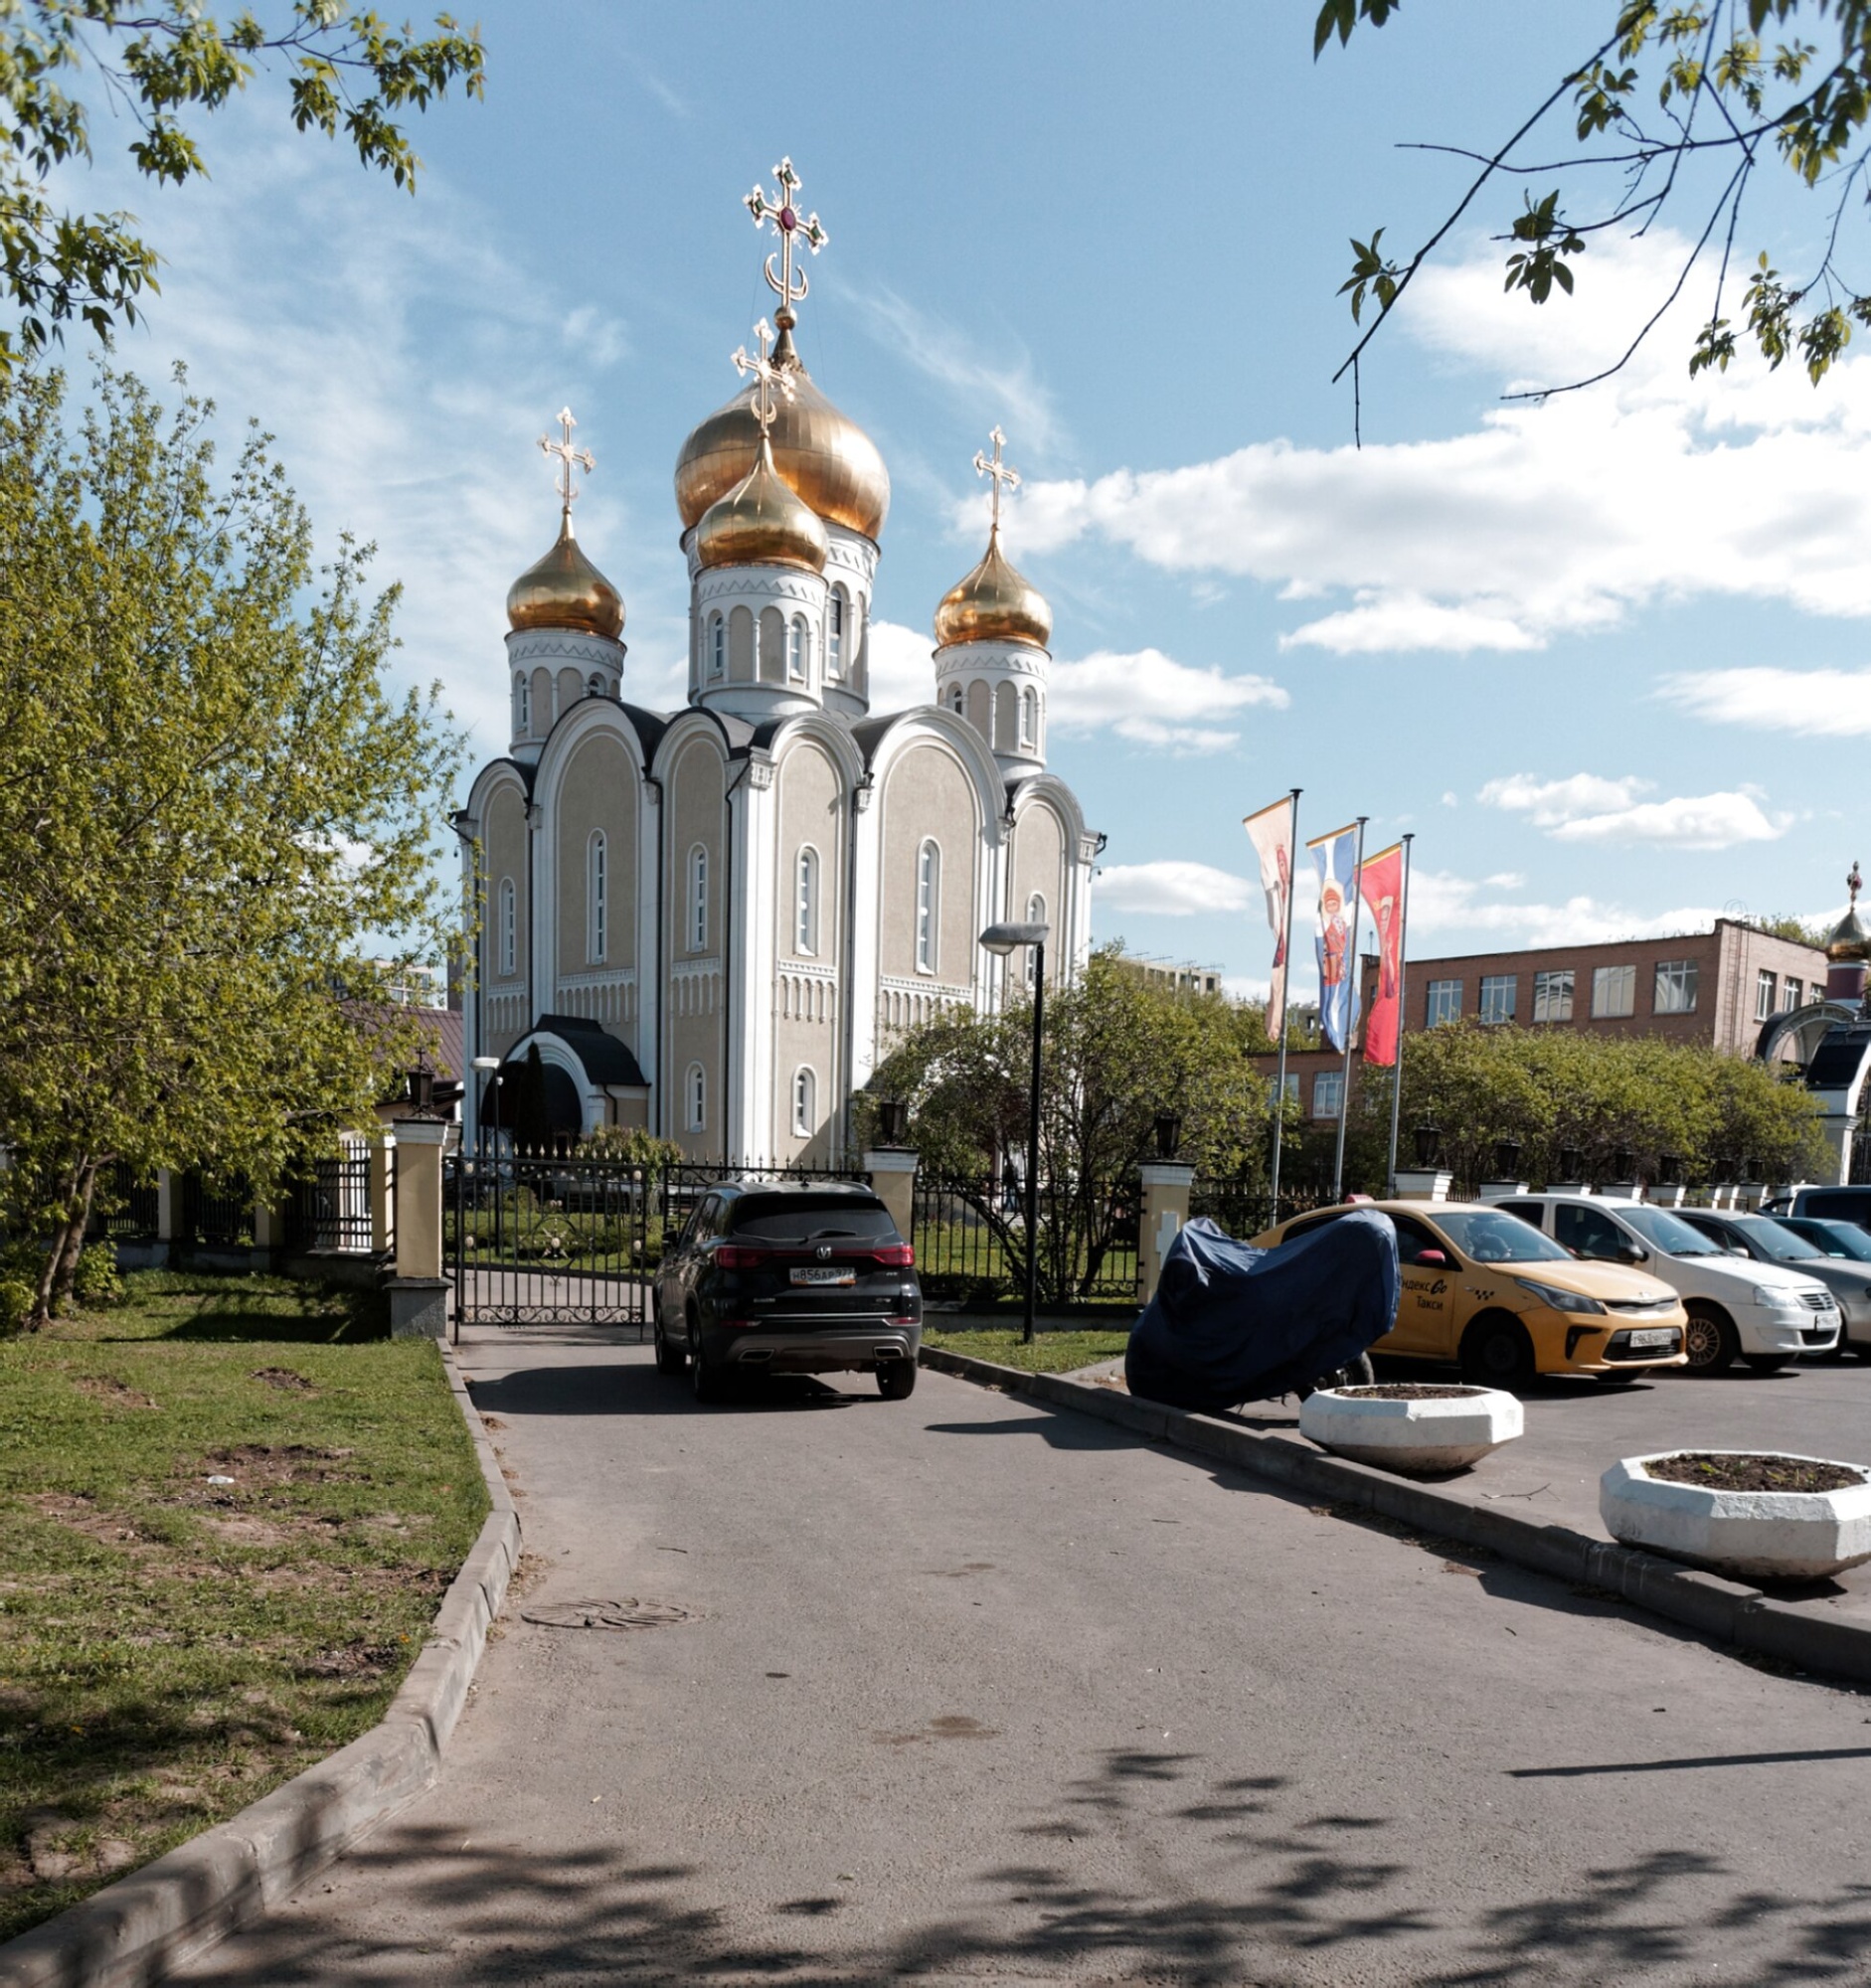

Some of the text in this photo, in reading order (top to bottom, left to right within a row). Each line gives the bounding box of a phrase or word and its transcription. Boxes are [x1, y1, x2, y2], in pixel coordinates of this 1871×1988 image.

[1400, 1276, 1447, 1294] ндекс Go
[1417, 1295, 1444, 1311] Такси
